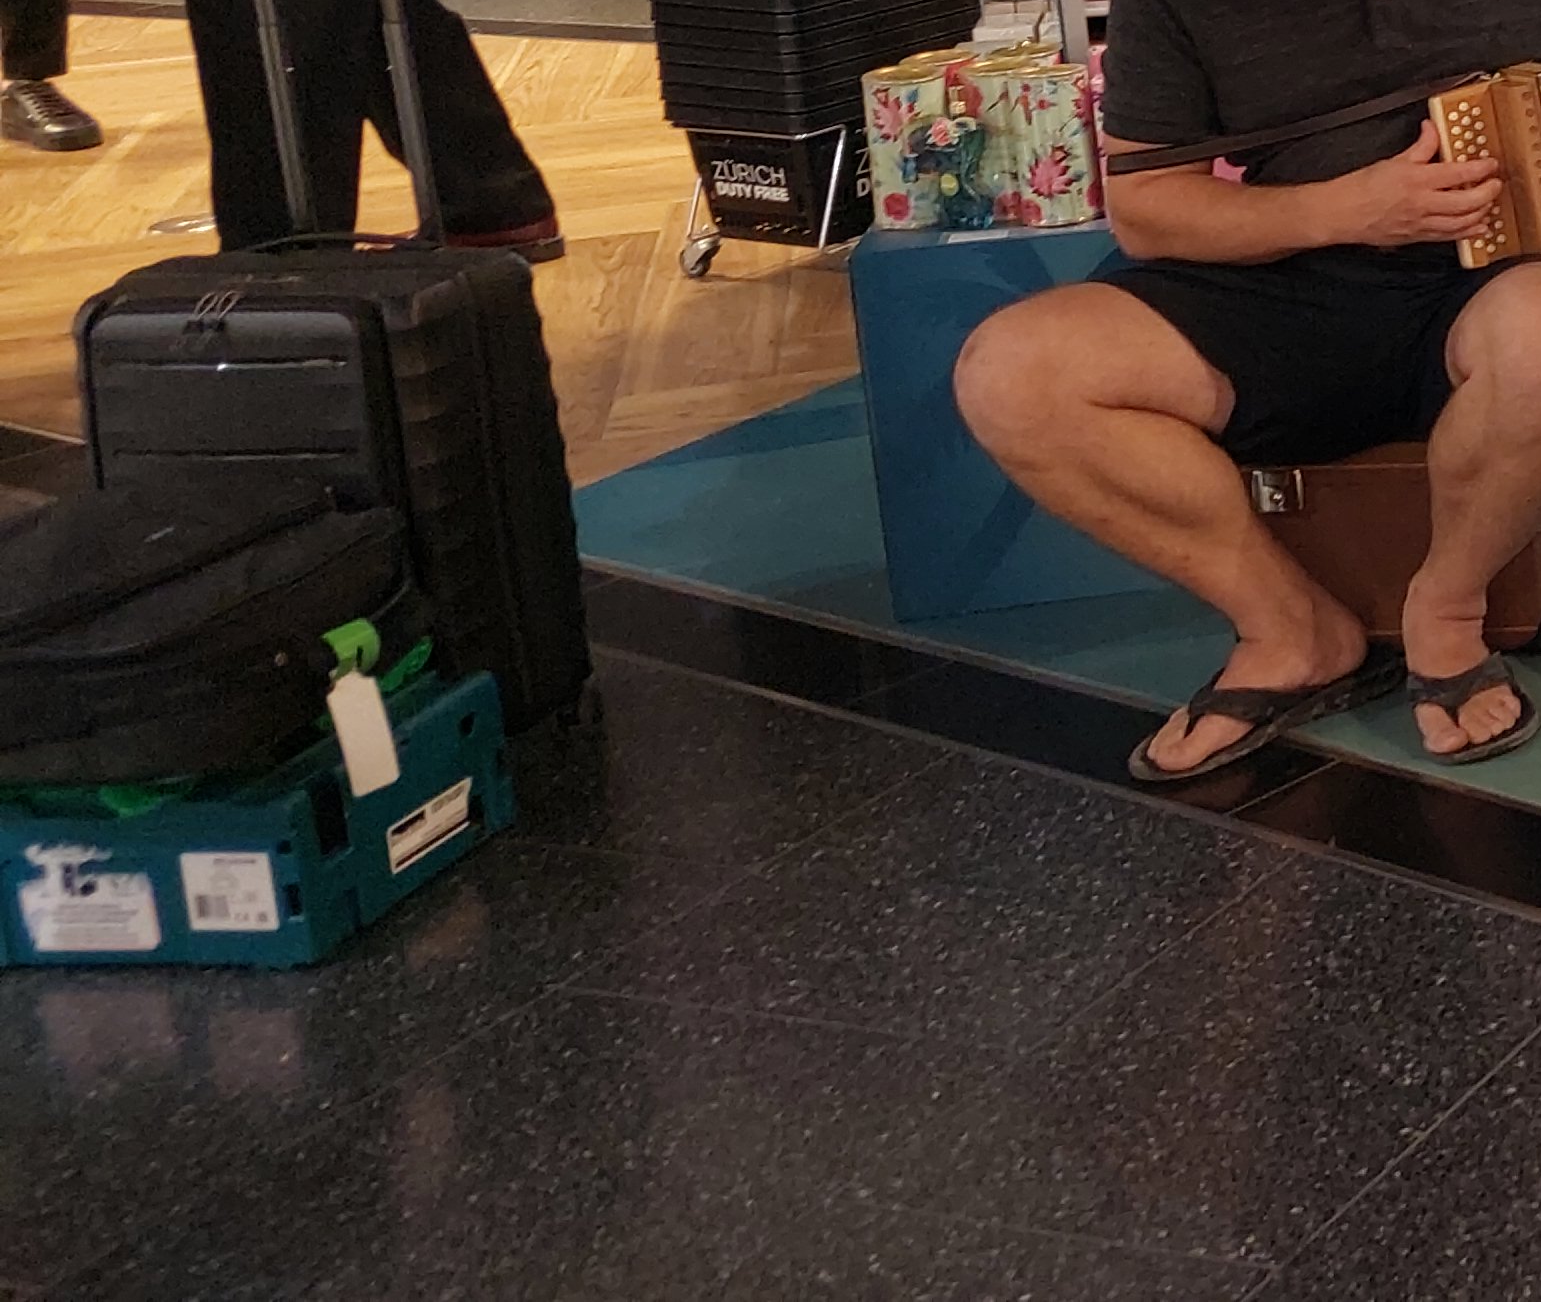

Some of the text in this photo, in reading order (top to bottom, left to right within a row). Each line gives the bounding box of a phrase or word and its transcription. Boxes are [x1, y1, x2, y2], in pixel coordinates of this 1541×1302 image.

[711, 159, 786, 186] ZÜRICH
[715, 181, 790, 203] DUTY FREE
